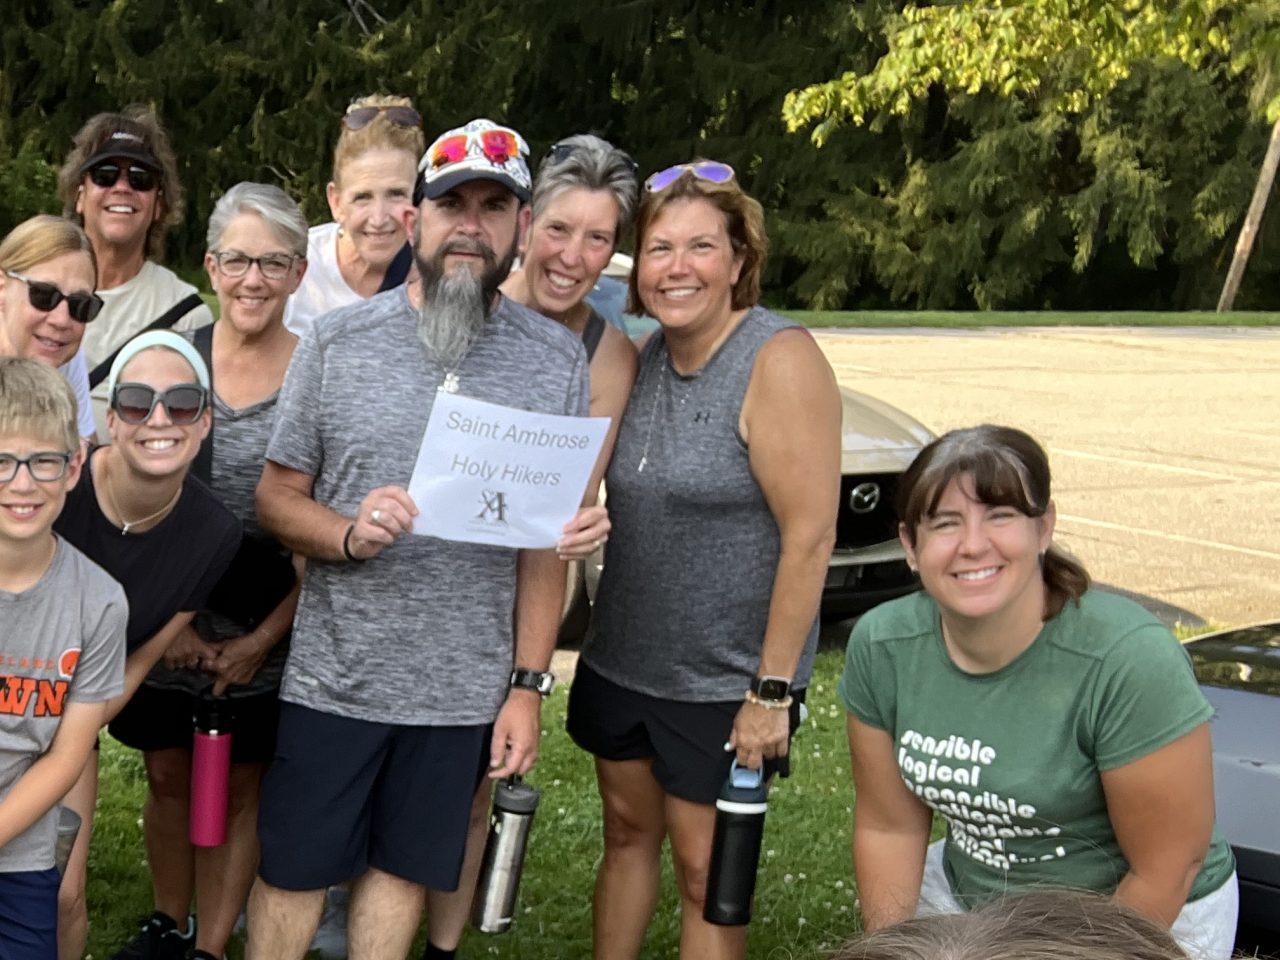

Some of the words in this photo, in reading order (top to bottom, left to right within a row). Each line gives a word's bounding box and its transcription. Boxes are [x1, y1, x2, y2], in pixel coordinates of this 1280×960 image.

[446, 411, 500, 440] Saint
[503, 424, 590, 450] Ambrose
[450, 454, 499, 482] Holy
[501, 463, 562, 486] Hikers
[900, 730, 996, 765] sensible
[898, 747, 981, 787] logical
